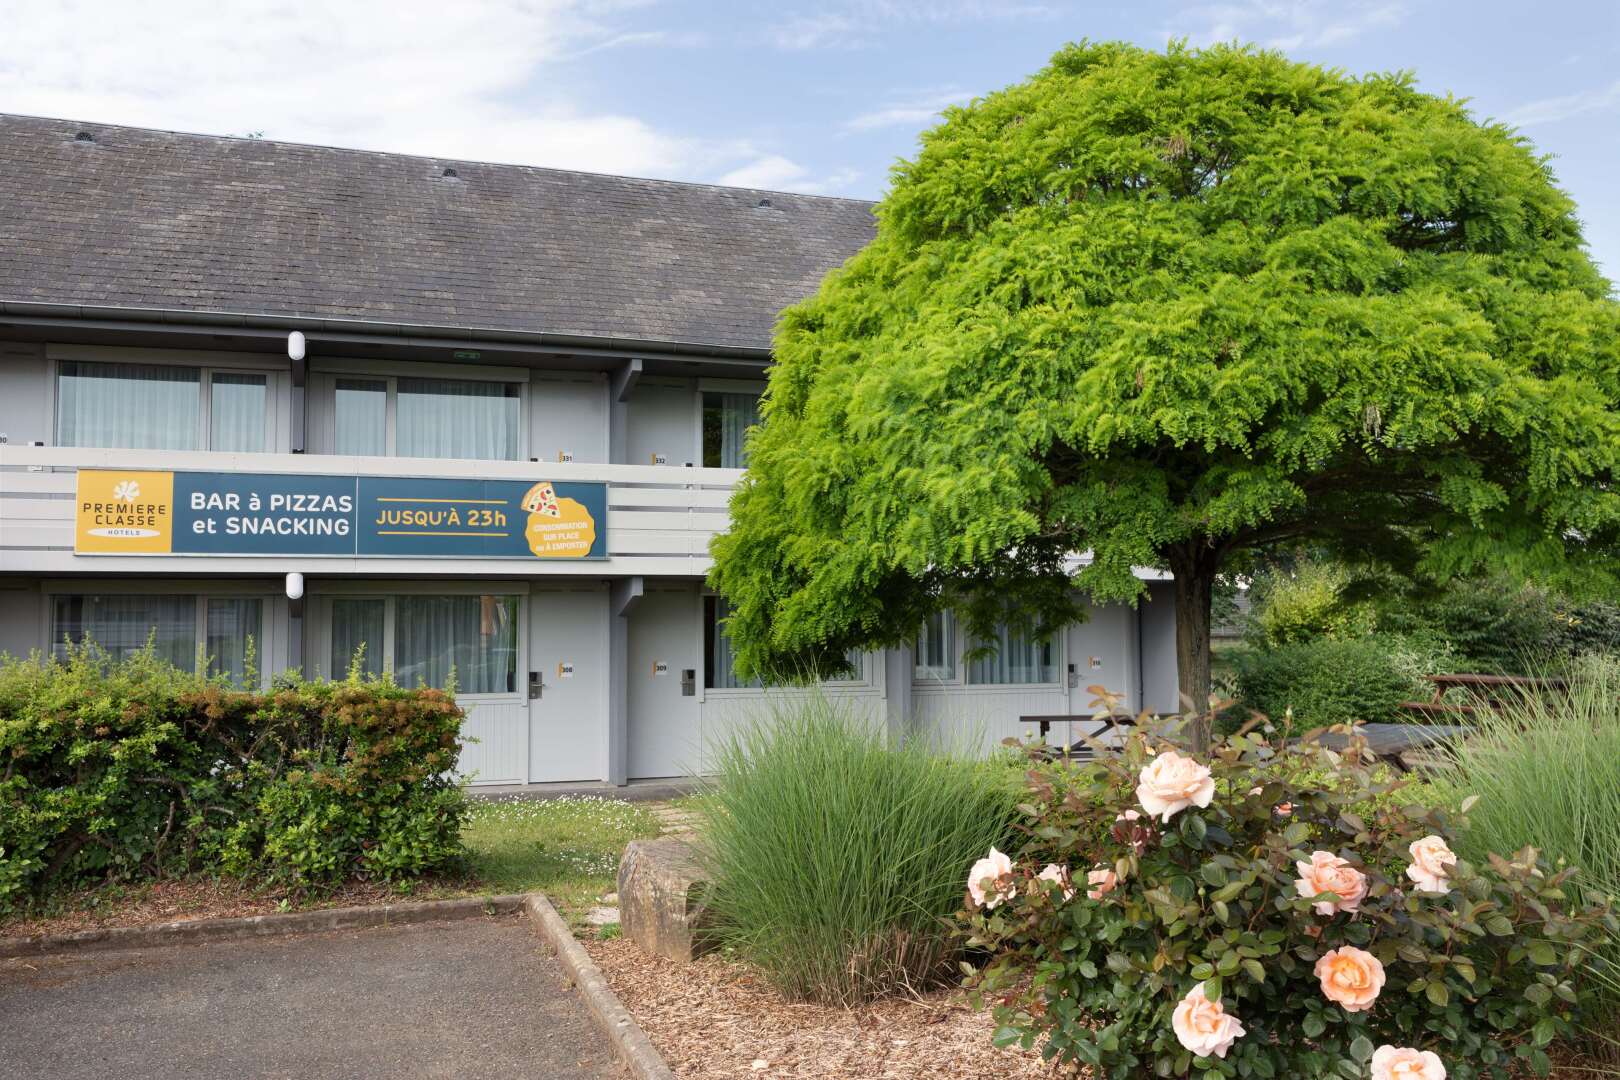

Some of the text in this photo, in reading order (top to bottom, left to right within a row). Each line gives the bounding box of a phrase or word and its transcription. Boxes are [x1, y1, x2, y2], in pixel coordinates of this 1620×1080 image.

[83, 503, 166, 515] PREMIERE
[190, 493, 353, 513] BAR à PIZZAS
[95, 514, 156, 526] CLASSE
[192, 517, 350, 536] et SNACKING
[375, 508, 507, 527] JUSQU'À 23h
